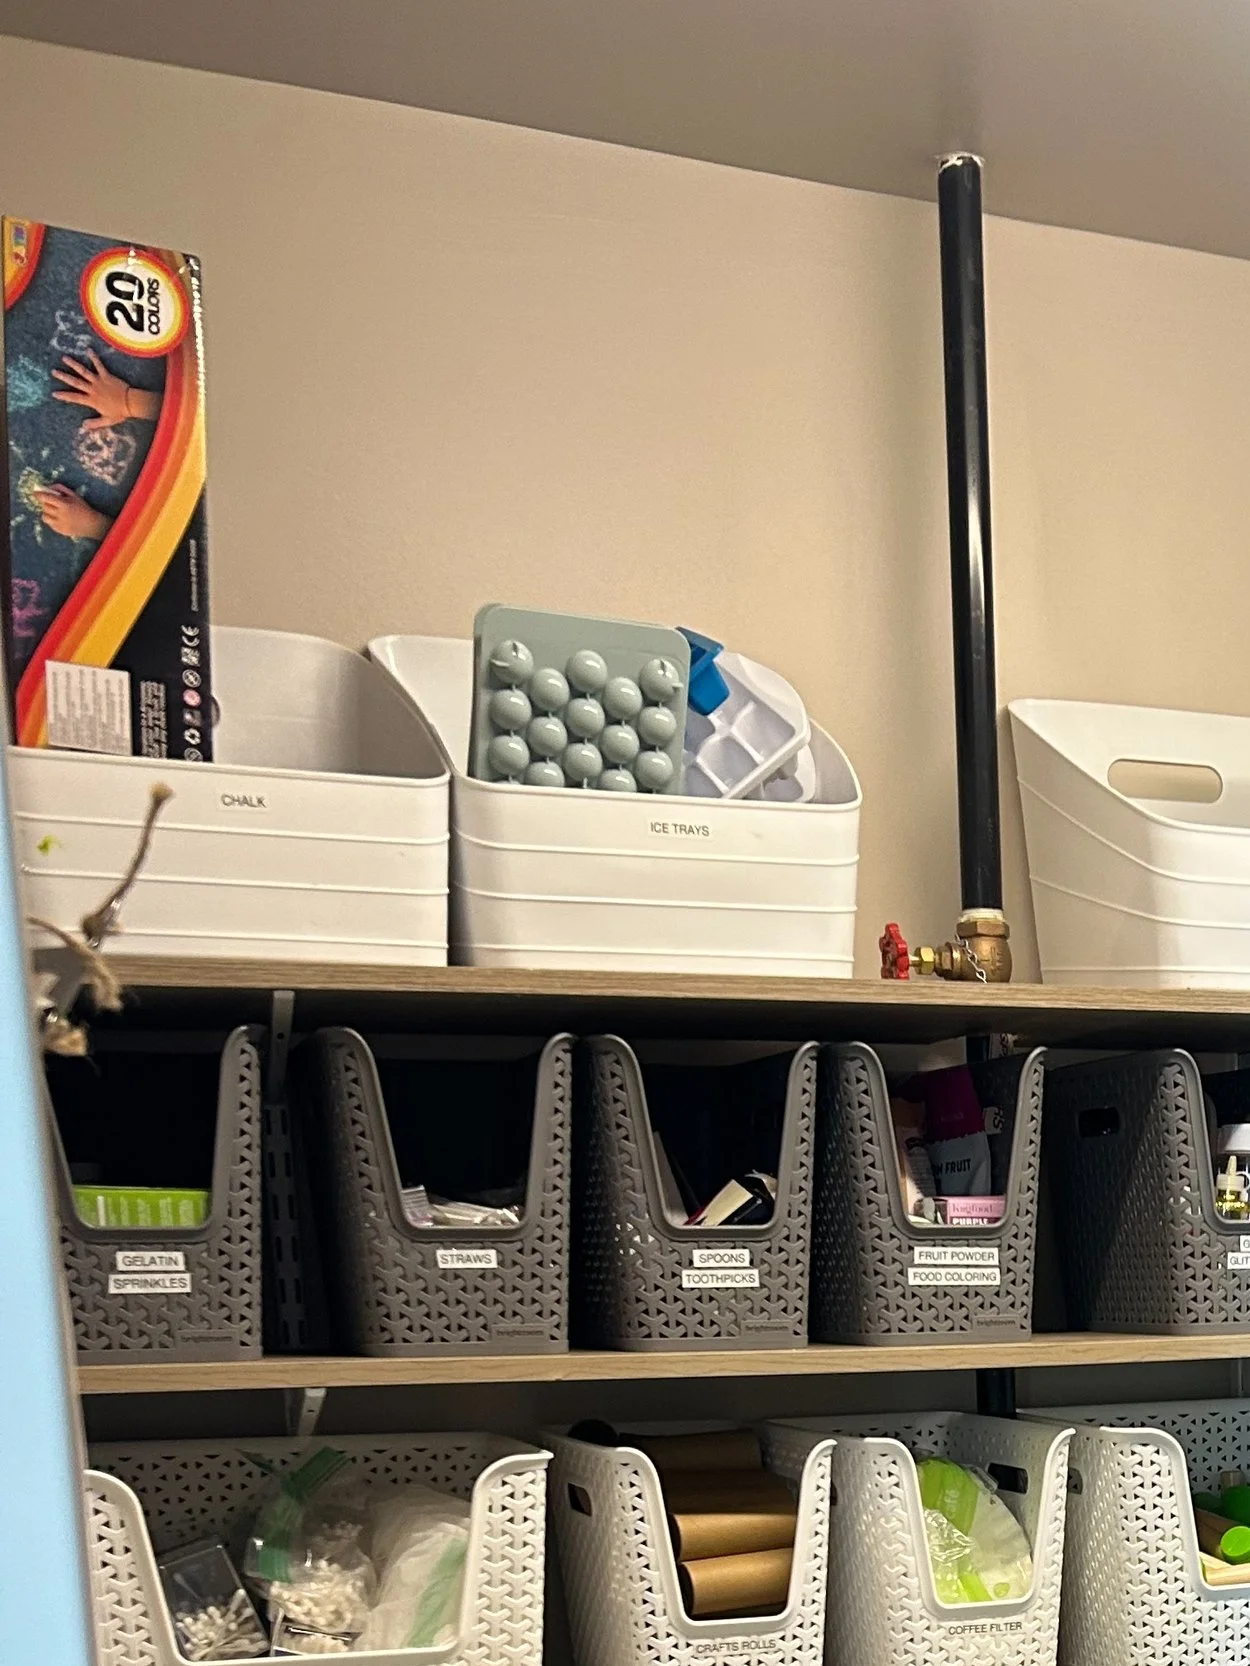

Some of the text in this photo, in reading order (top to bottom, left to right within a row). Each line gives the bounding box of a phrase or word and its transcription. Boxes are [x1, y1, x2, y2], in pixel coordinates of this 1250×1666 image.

[105, 271, 145, 335] 20
[147, 277, 161, 337] COLORS
[221, 793, 267, 810] CHALK
[650, 822, 710, 837] ICE TRAYS
[945, 1159, 971, 1174] FRUIT
[122, 1255, 179, 1267] GELATIN
[440, 1253, 493, 1266] STRAWS
[698, 1252, 746, 1264] SPOONS
[918, 1251, 996, 1262] FRUIT POWDER
[685, 1272, 756, 1284] TOOTHPICKS
[912, 1270, 998, 1283] FOOD COLORING
[113, 1277, 188, 1290] SPRINKLES
[949, 1621, 1023, 1635] COFFEE FILTER
[696, 1639, 777, 1653] CRAFTS ROLLS
